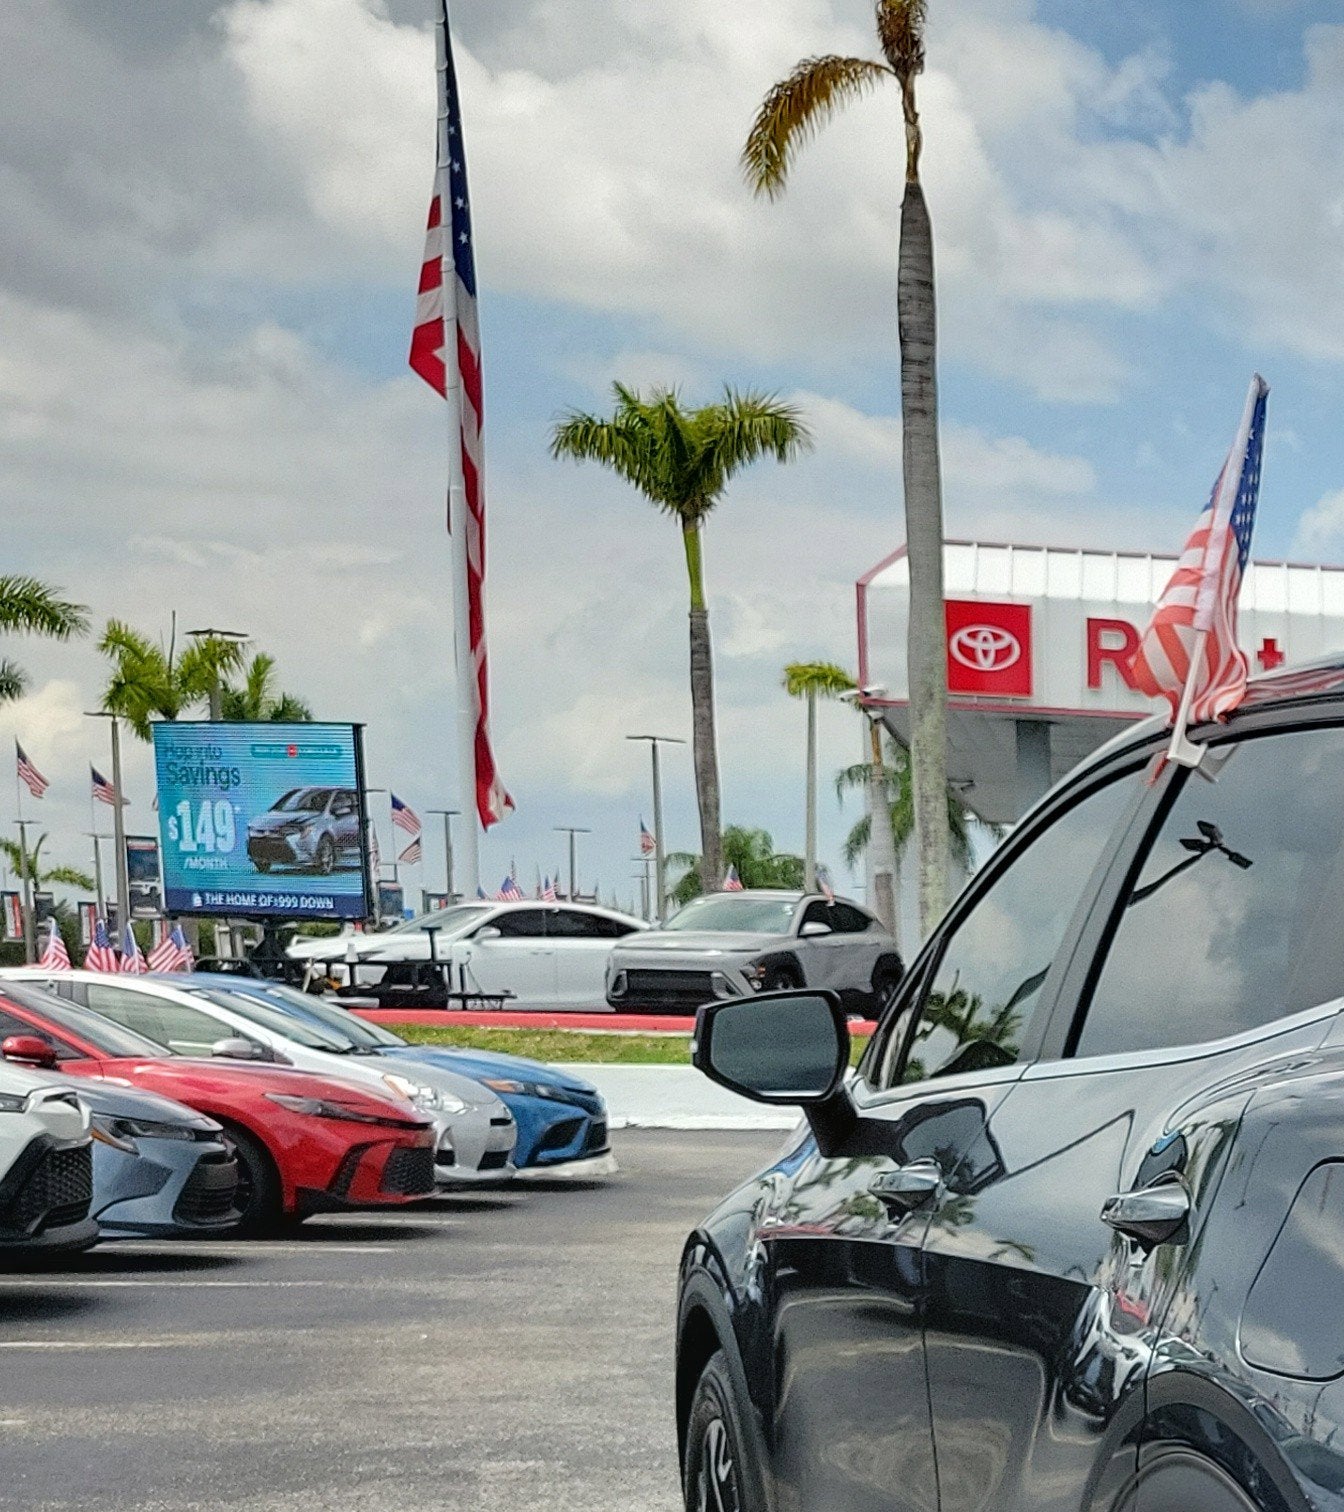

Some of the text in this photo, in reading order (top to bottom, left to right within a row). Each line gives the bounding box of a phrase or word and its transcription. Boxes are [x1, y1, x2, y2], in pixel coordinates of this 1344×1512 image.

[166, 760, 241, 791] Savings
[205, 892, 223, 905] THE
[226, 893, 256, 906] HOME
[300, 896, 334, 909] DOWN
